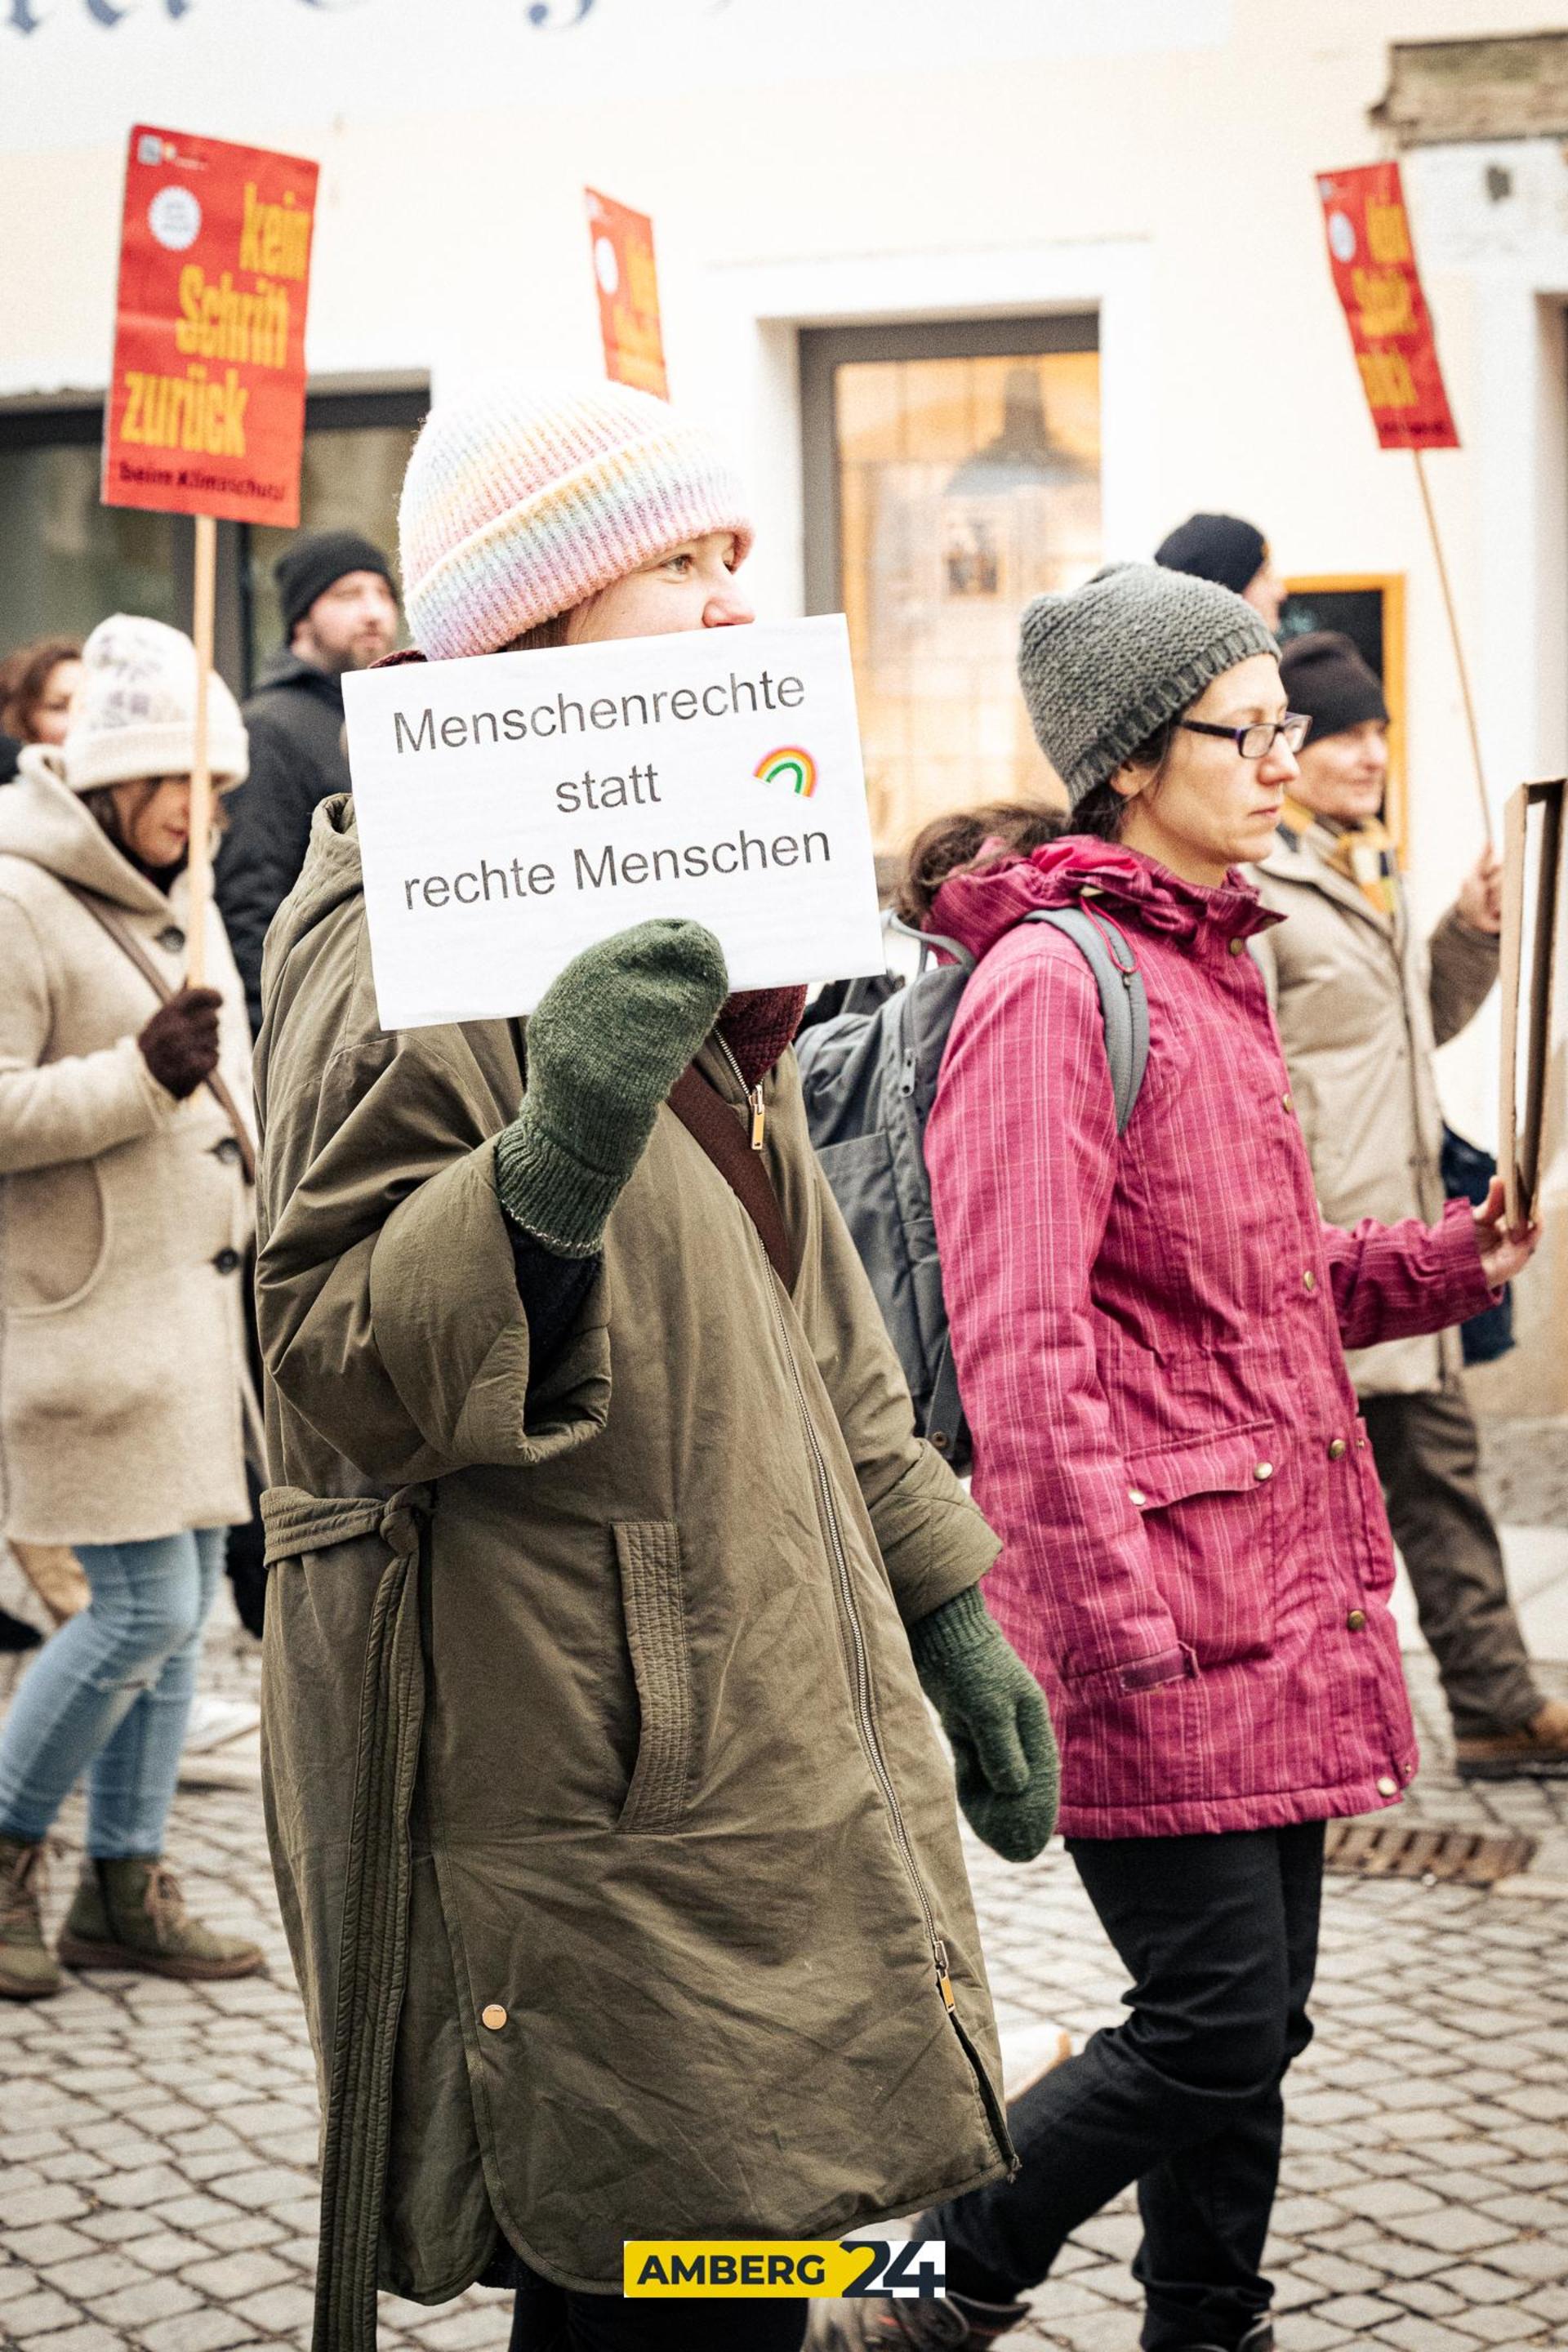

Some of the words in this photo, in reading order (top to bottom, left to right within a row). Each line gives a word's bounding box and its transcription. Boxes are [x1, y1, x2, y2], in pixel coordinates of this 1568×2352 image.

[239, 181, 313, 280] kein
[176, 263, 289, 369] Schritt
[120, 363, 248, 458] zurück
[394, 670, 806, 753] Menschenrechte
[555, 763, 662, 813] statt
[405, 858, 555, 910] rechte
[574, 830, 831, 890] Menschen
